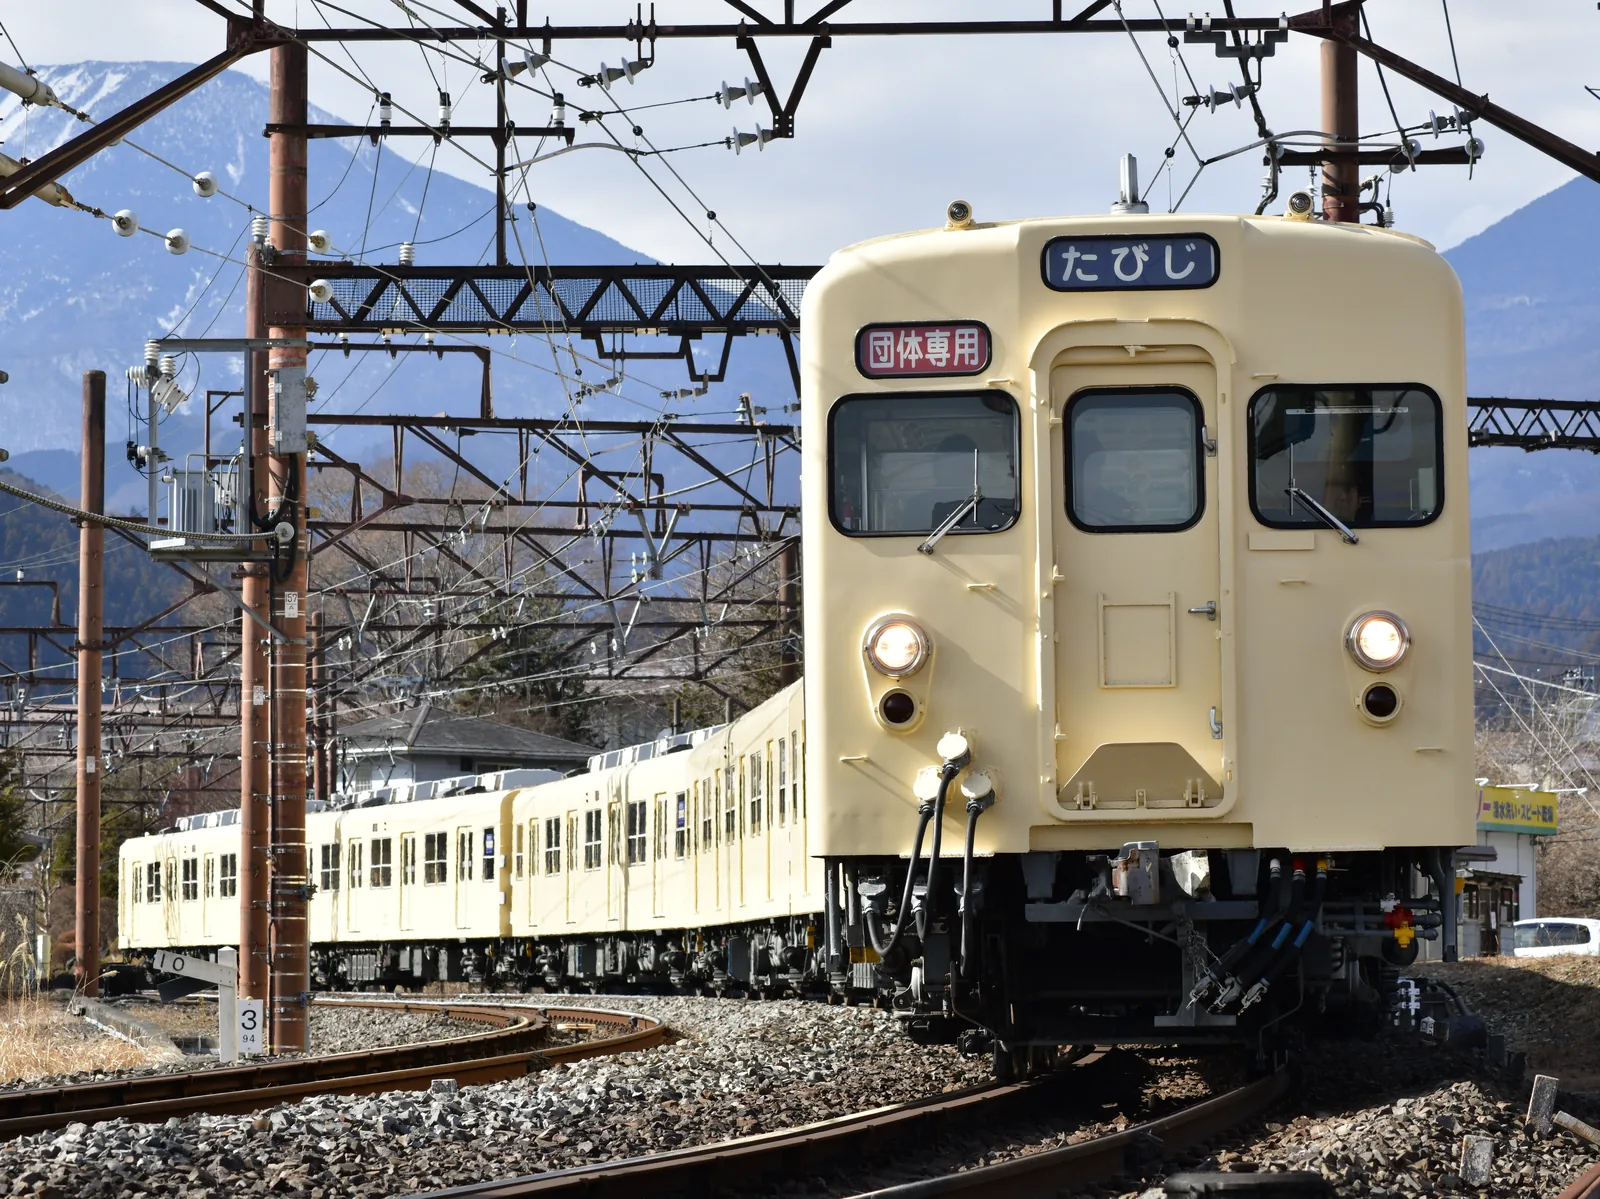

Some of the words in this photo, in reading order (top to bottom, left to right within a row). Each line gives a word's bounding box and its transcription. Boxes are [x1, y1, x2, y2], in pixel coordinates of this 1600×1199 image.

[1061, 242, 1196, 282] たびじ
[869, 328, 979, 369] 団体専用
[285, 593, 298, 603] 157
[241, 1009, 257, 1031] 3
[242, 1034, 256, 1043] 94
